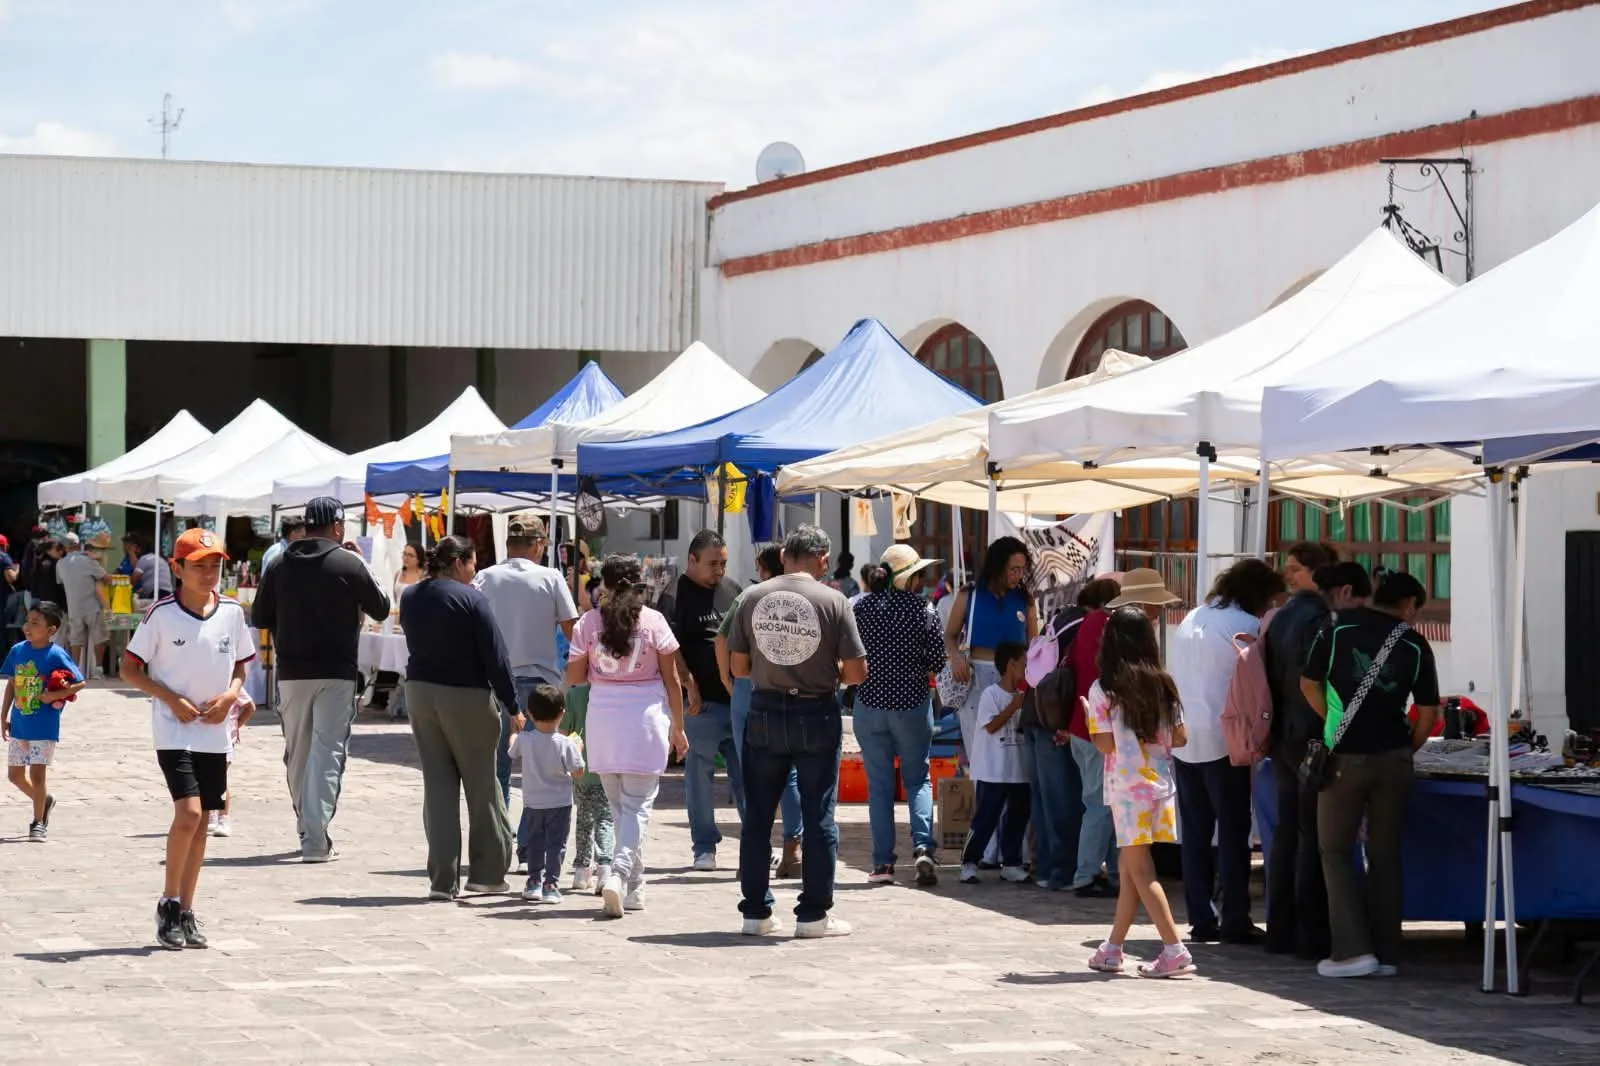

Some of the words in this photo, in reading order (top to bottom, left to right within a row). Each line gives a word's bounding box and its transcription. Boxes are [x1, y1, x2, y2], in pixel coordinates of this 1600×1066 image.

[754, 622, 774, 632] CABO
[774, 623, 790, 633] SAN
[790, 625, 817, 638] LUCAS
